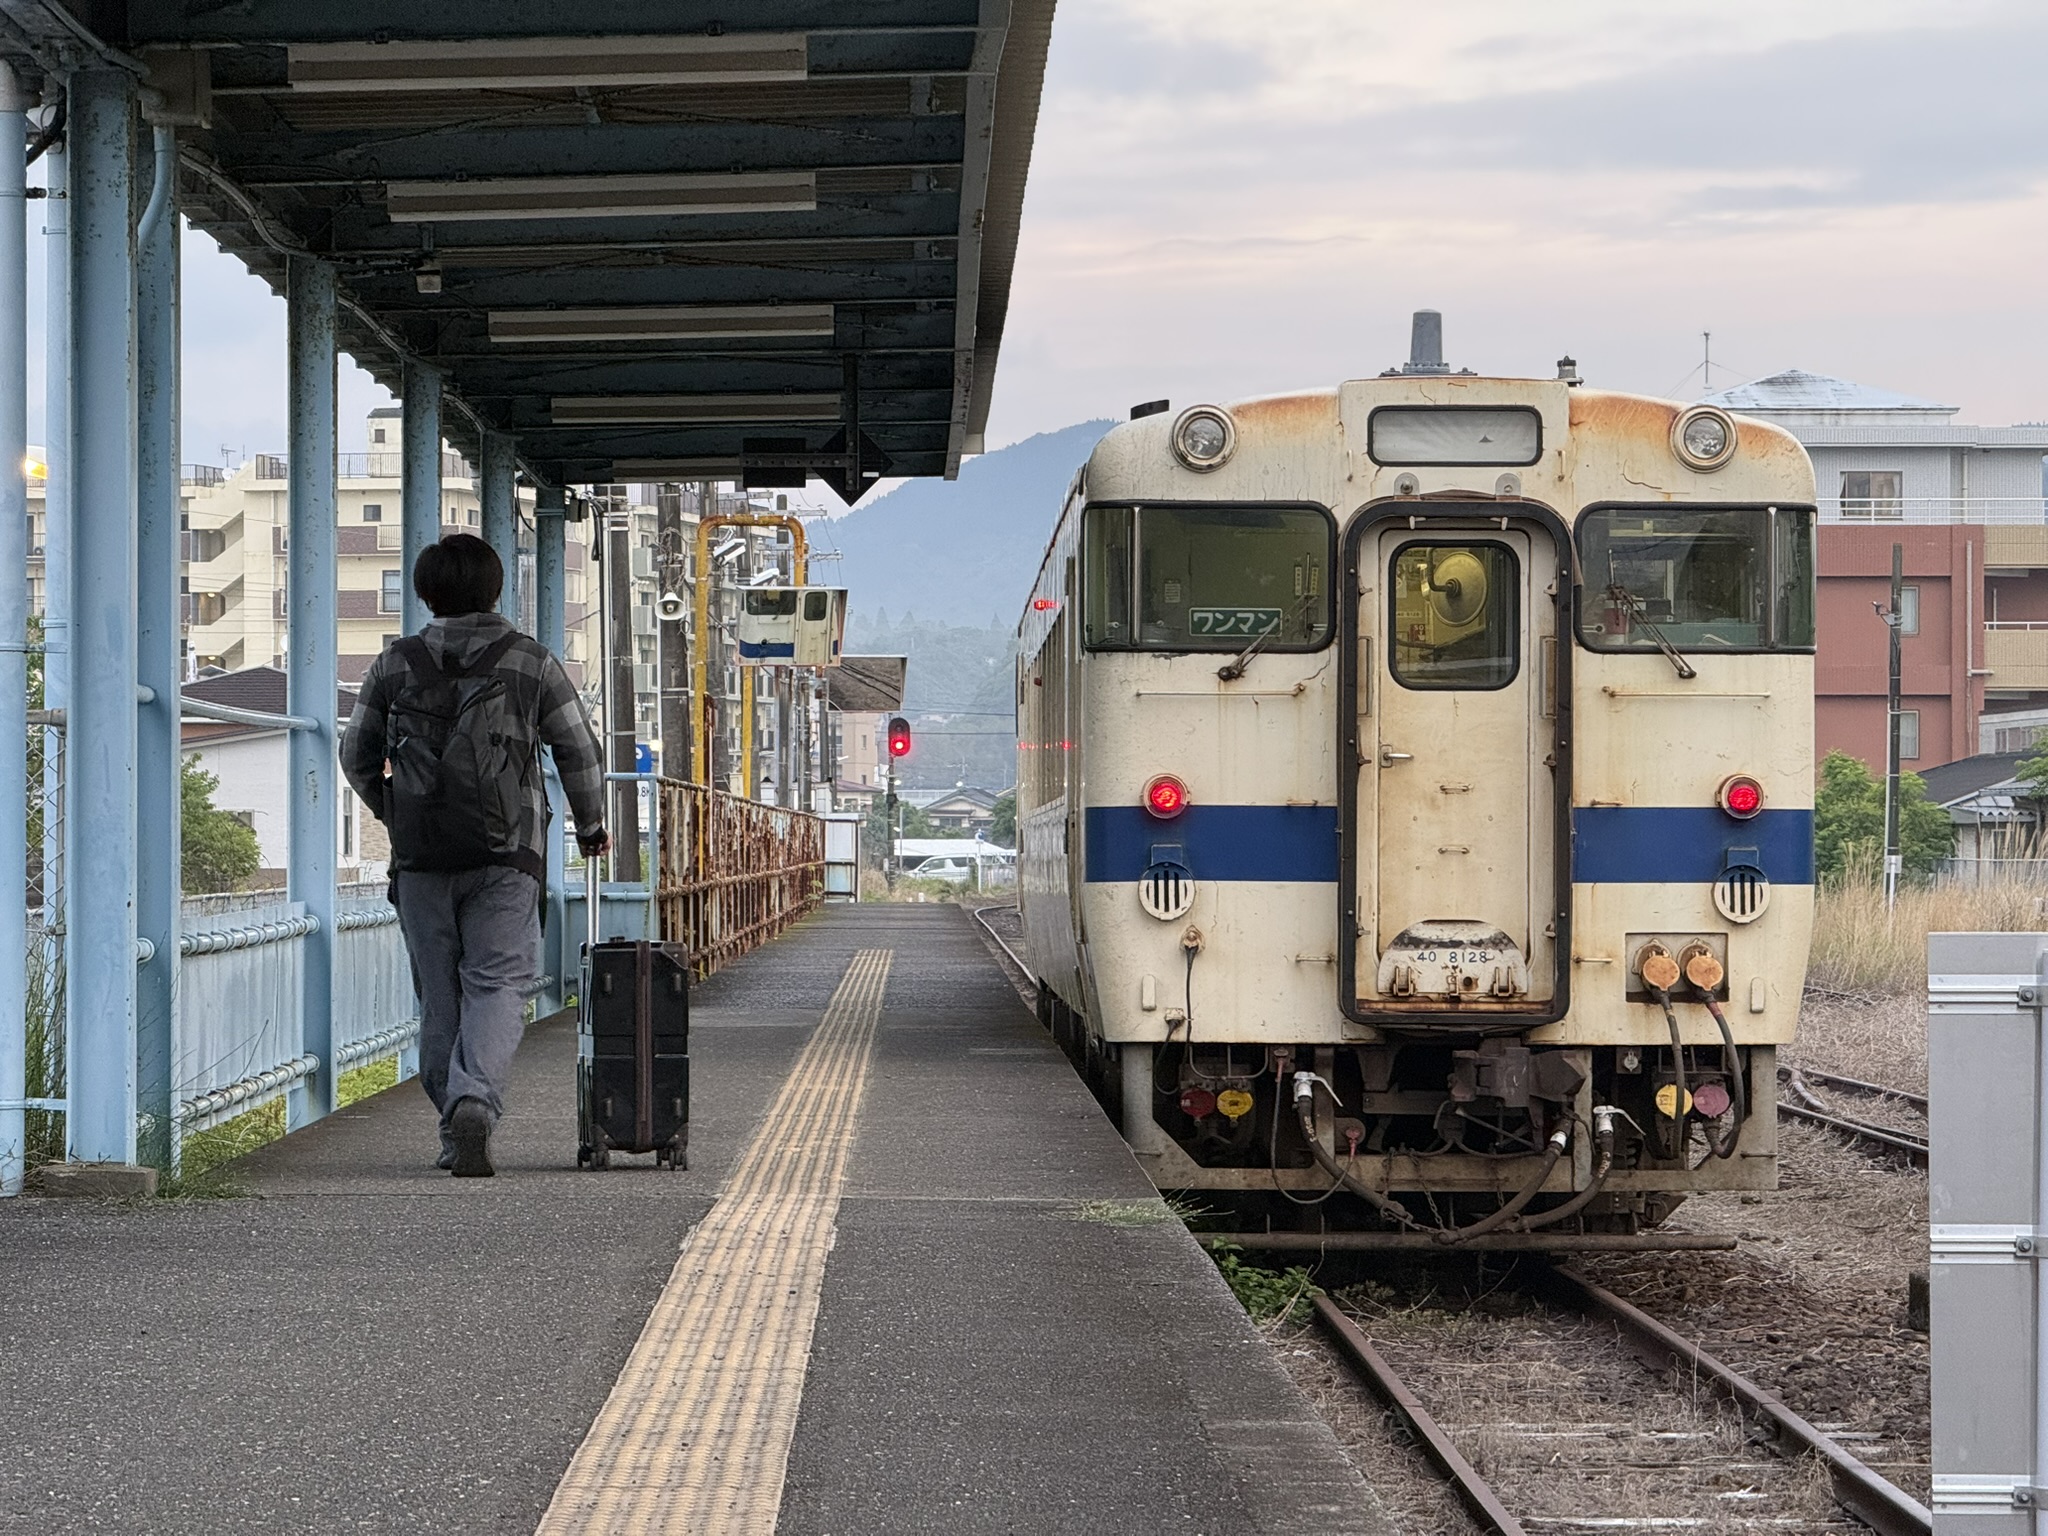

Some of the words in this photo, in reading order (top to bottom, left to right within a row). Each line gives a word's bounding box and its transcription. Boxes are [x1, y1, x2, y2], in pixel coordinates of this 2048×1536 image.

[1193, 612, 1279, 633] ワンマン
[1417, 951, 1437, 963] 40
[1449, 951, 1488, 963] 8128
